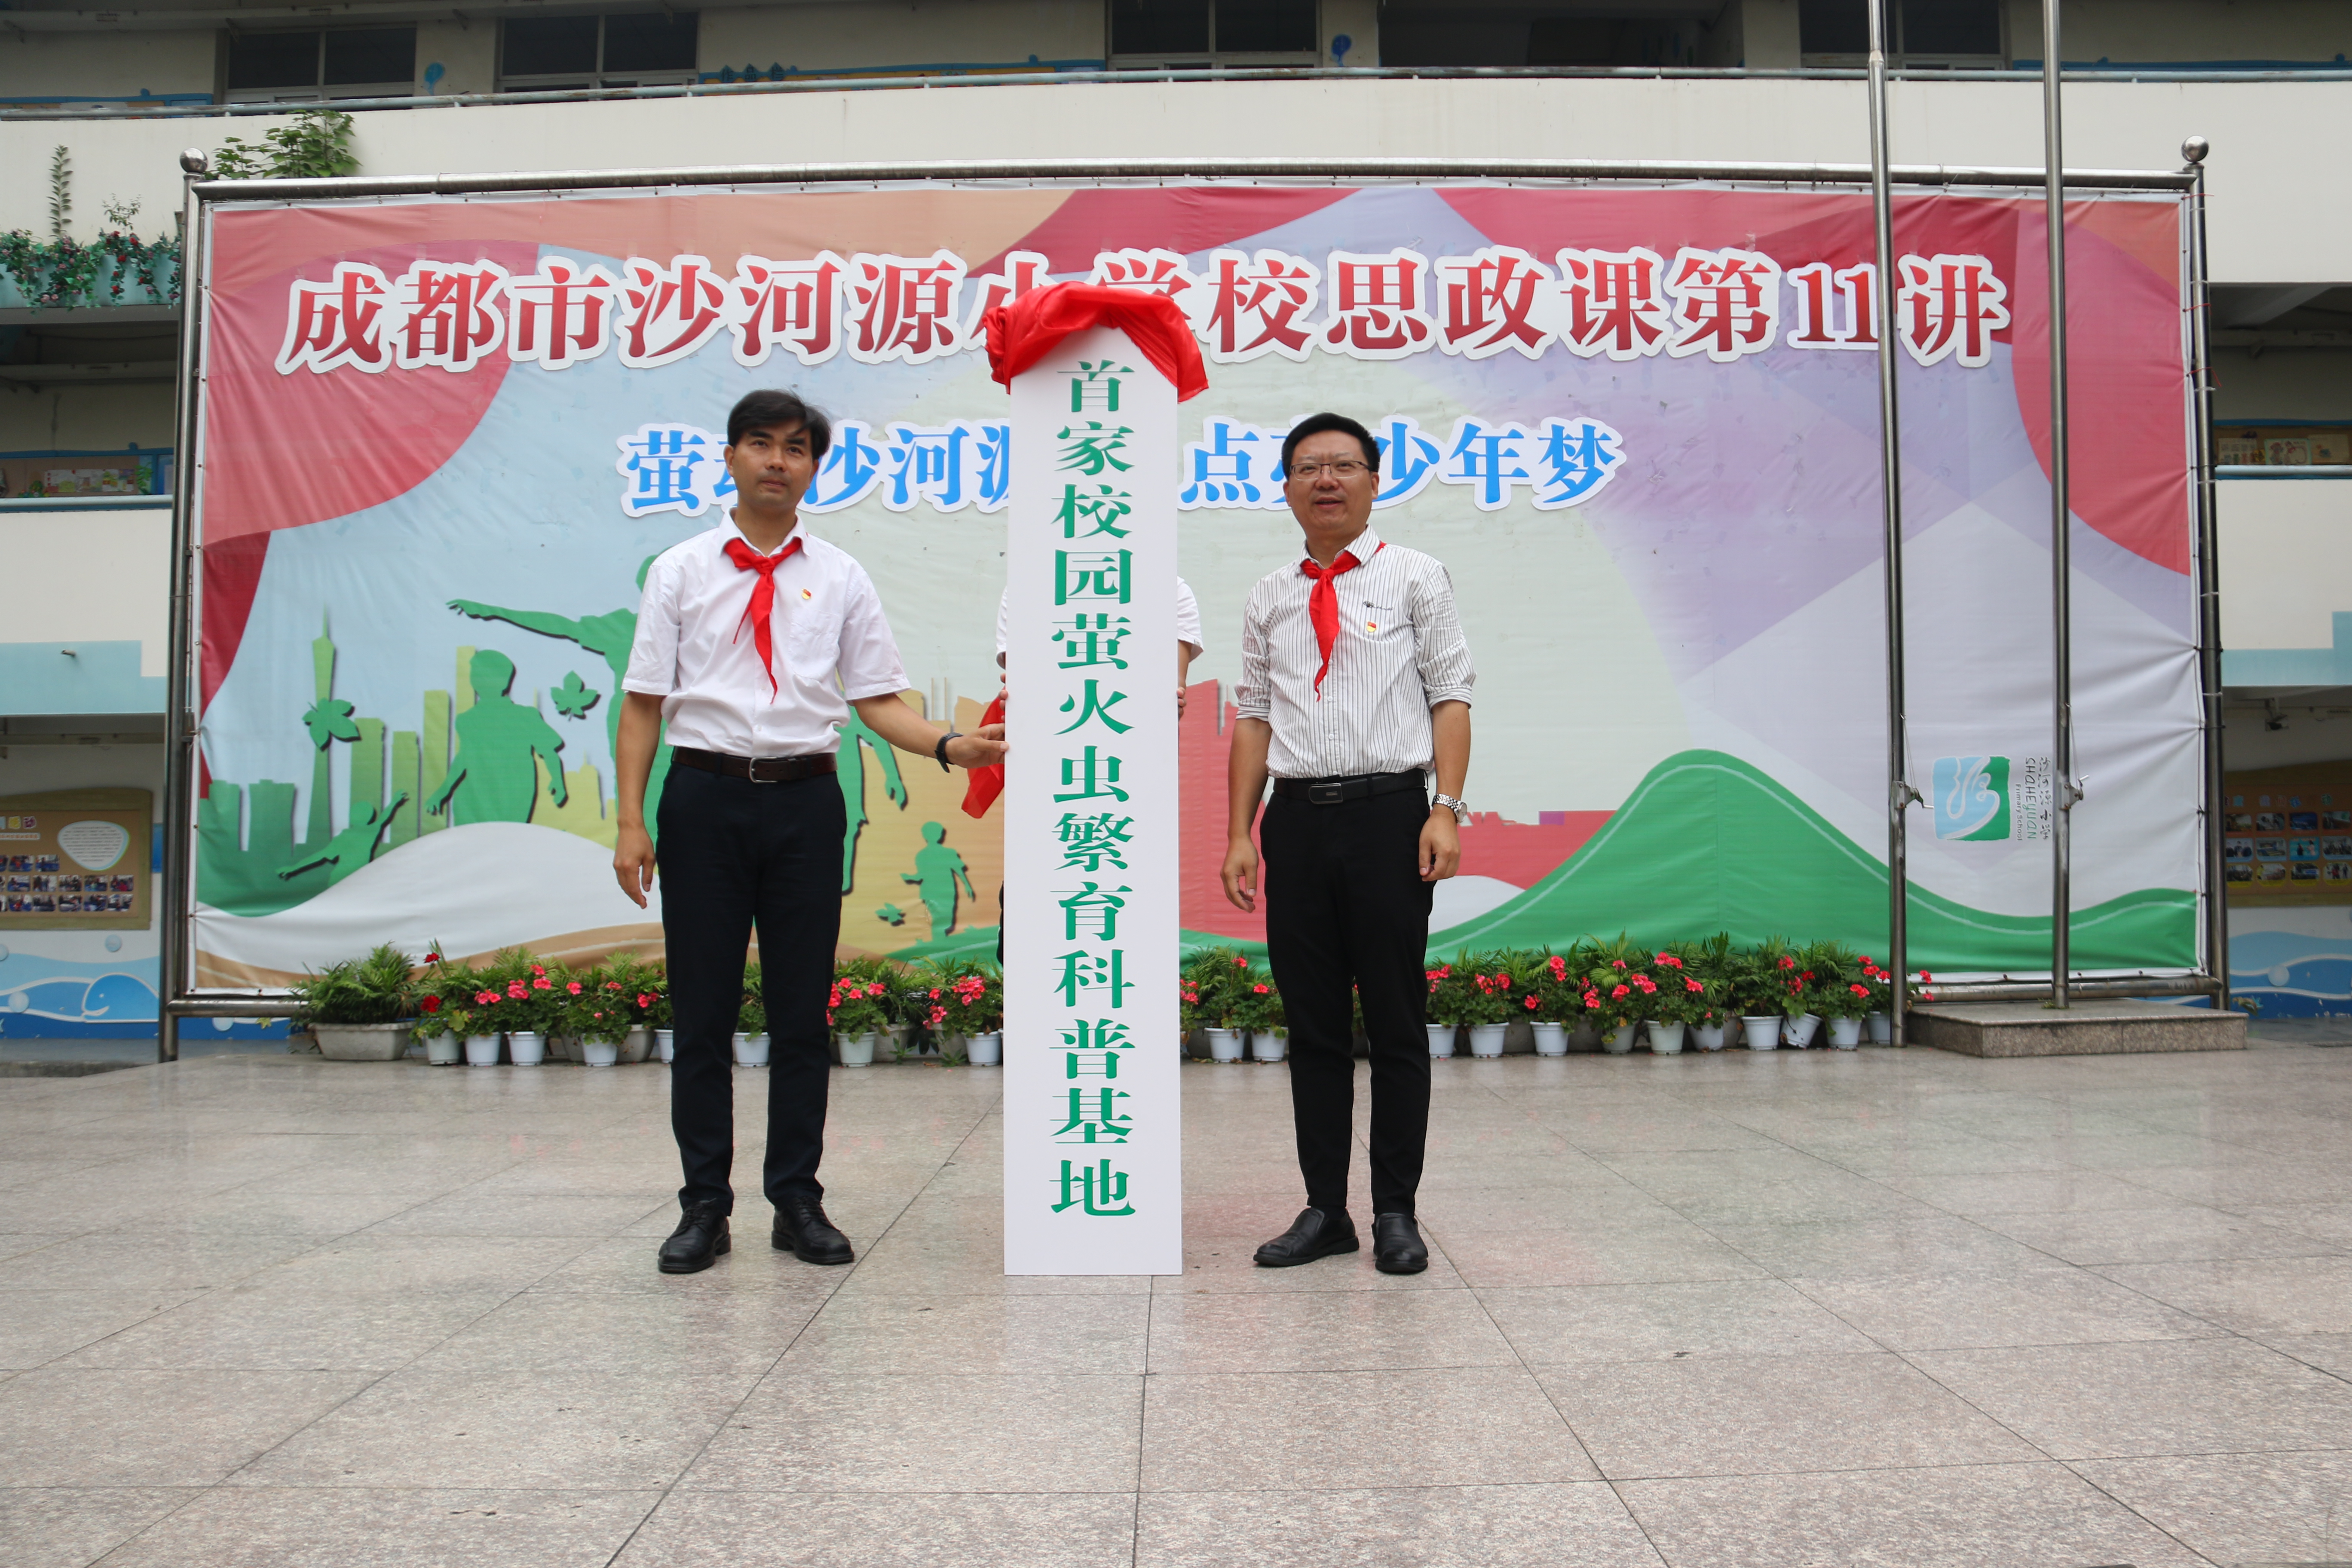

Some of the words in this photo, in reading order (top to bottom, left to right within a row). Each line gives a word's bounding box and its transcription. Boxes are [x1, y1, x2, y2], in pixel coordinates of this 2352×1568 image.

[720, 65, 784, 81] 作品栏
[627, 426, 1010, 510] 萤沙河
[1180, 421, 1615, 504] 点少年梦
[1049, 358, 1136, 1217] 首家校园萤火虫繁育科普基地
